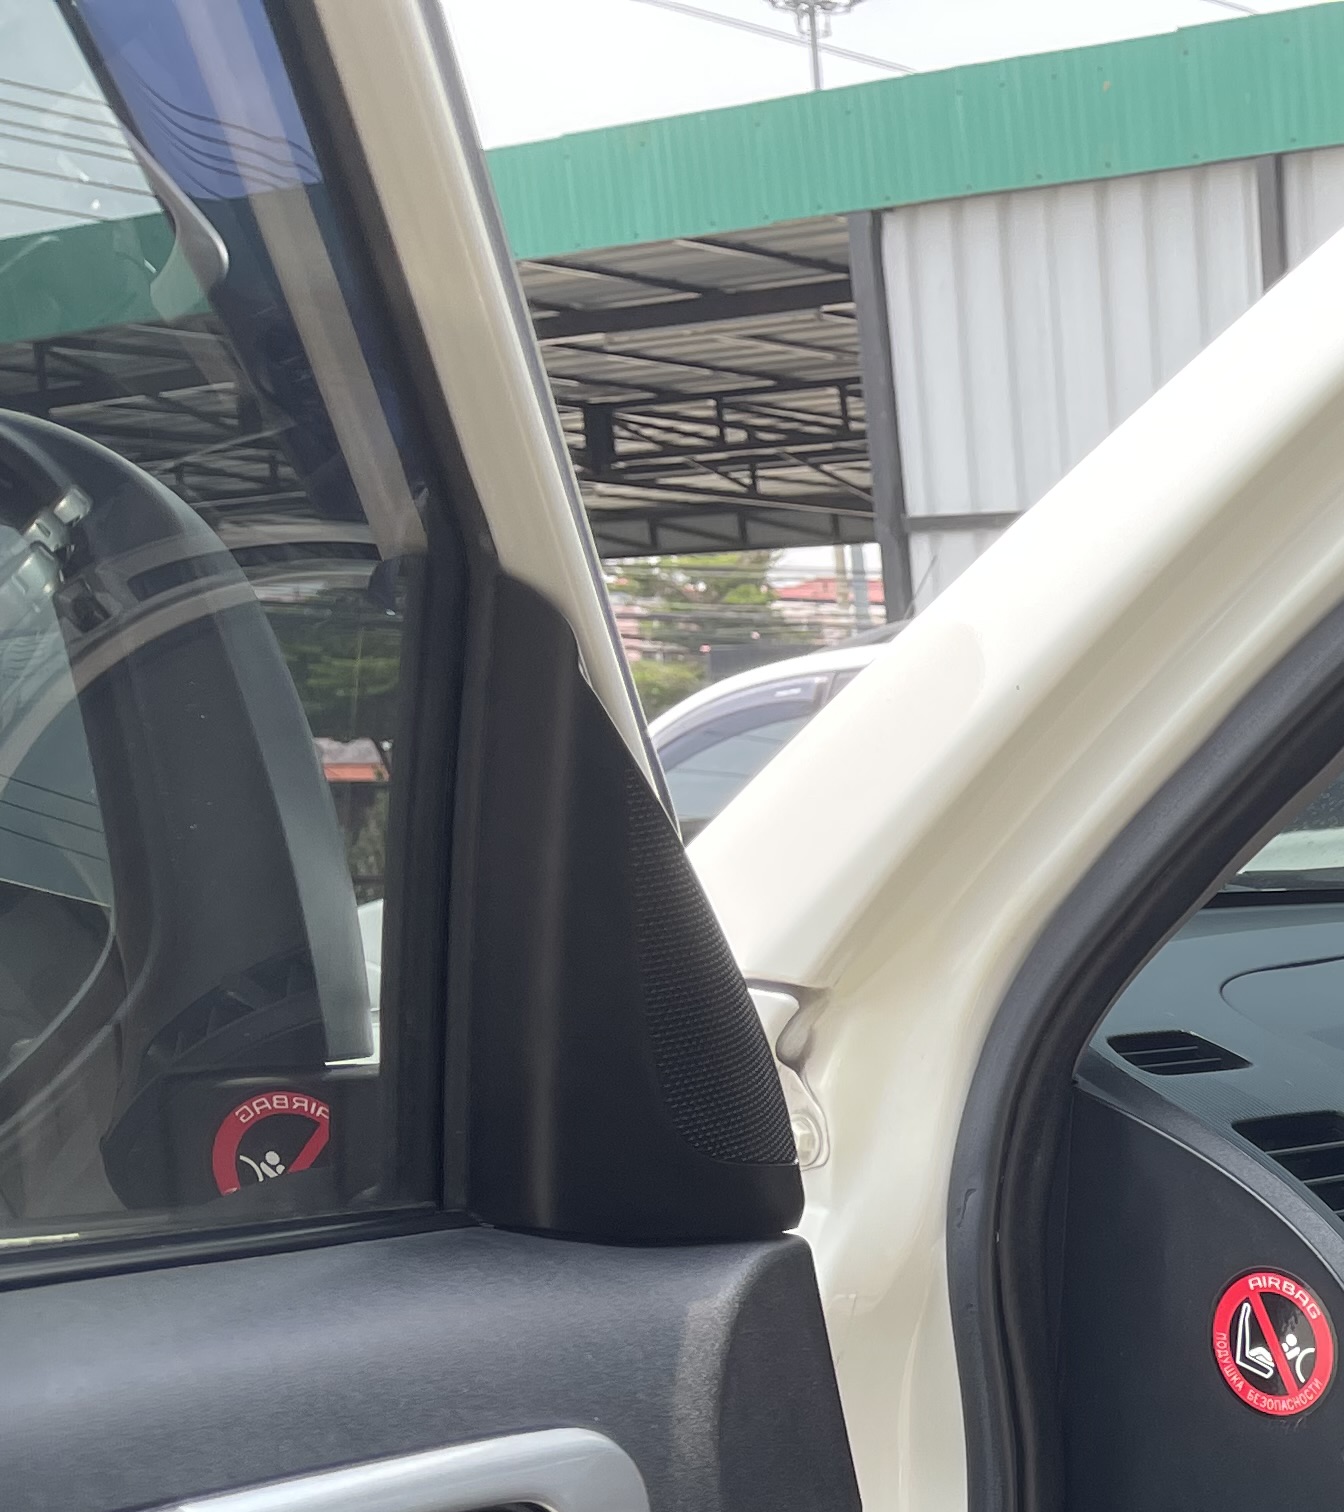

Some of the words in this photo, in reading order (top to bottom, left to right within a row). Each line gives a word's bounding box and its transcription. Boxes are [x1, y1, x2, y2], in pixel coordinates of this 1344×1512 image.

[1248, 1275, 1321, 1320] AIRBAG
[1215, 1331, 1245, 1392] ПОДУШКА
[1246, 1377, 1323, 1412] БЕЗОПАСНОСТИ
